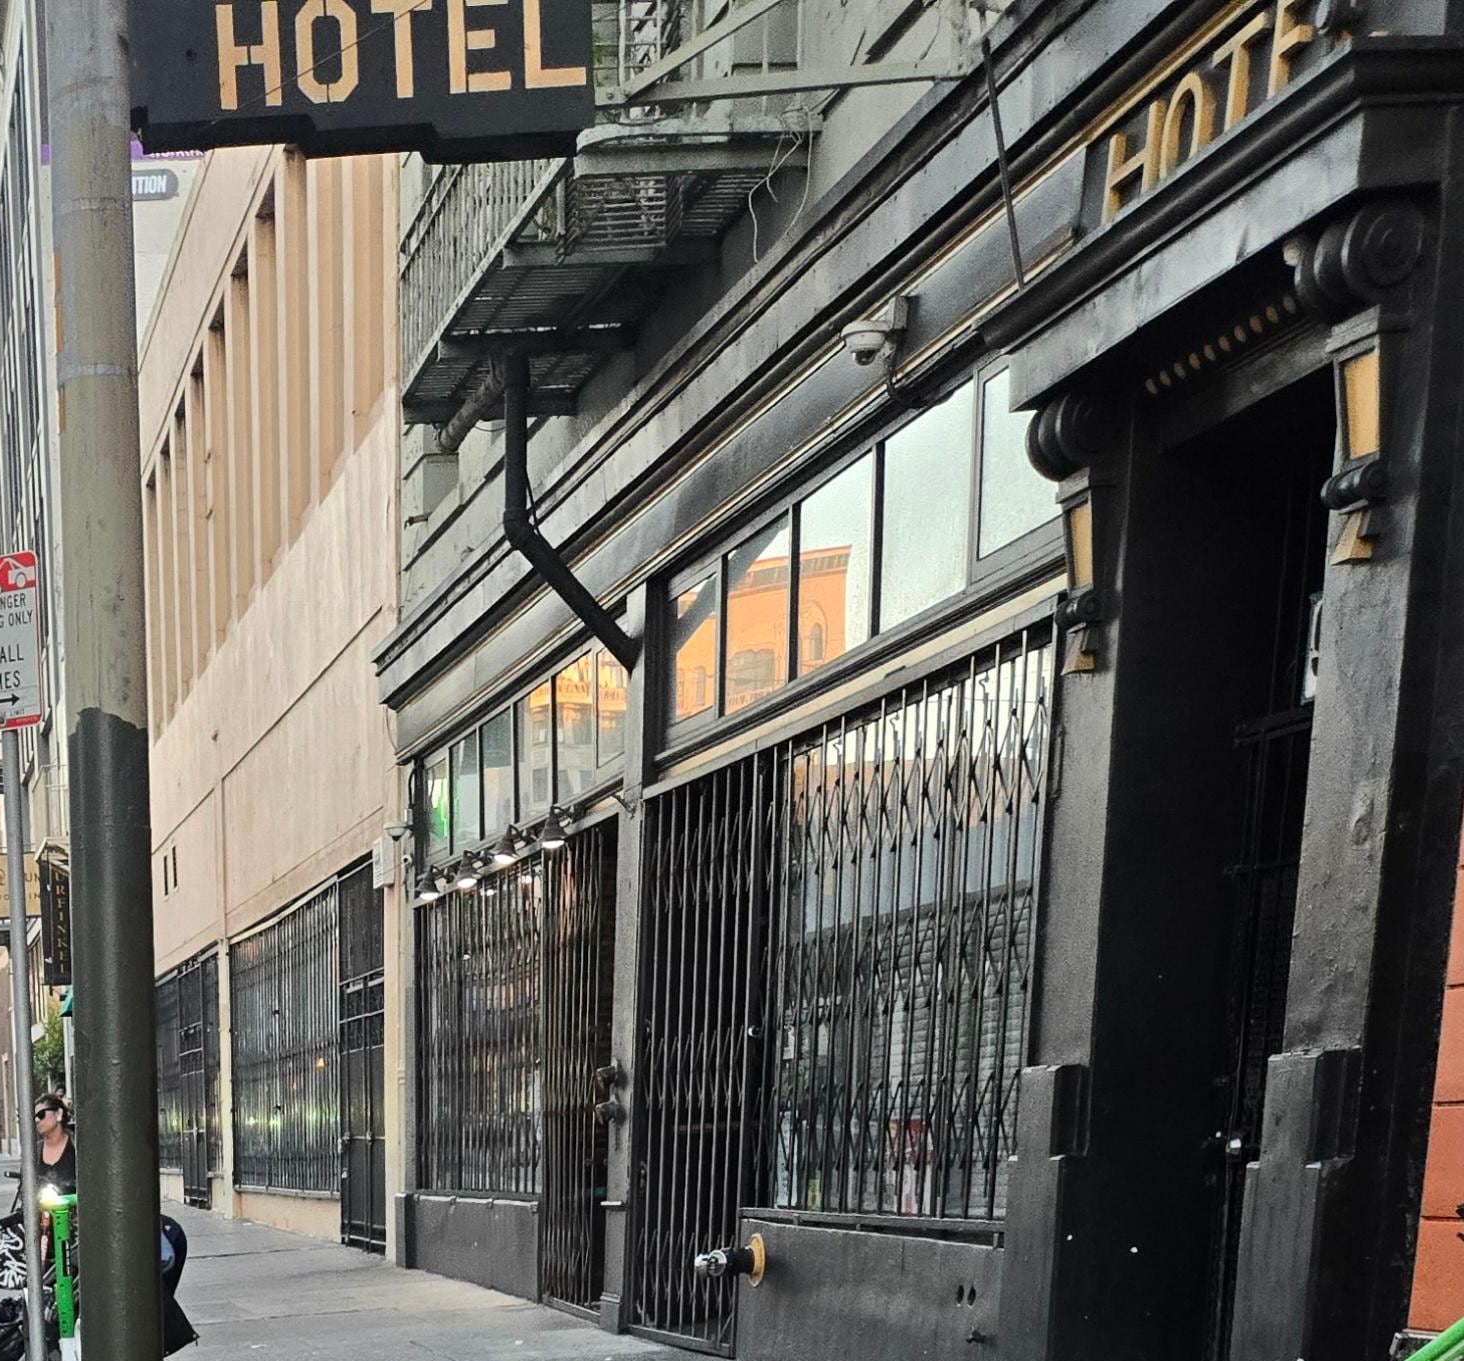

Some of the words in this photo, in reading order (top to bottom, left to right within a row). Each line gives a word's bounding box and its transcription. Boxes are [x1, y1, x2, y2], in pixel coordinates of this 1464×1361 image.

[215, 0, 587, 109] HOTEL
[1101, 0, 1316, 225] HOTE
[8, 610, 33, 627] ONLY
[0, 643, 24, 664] ALL
